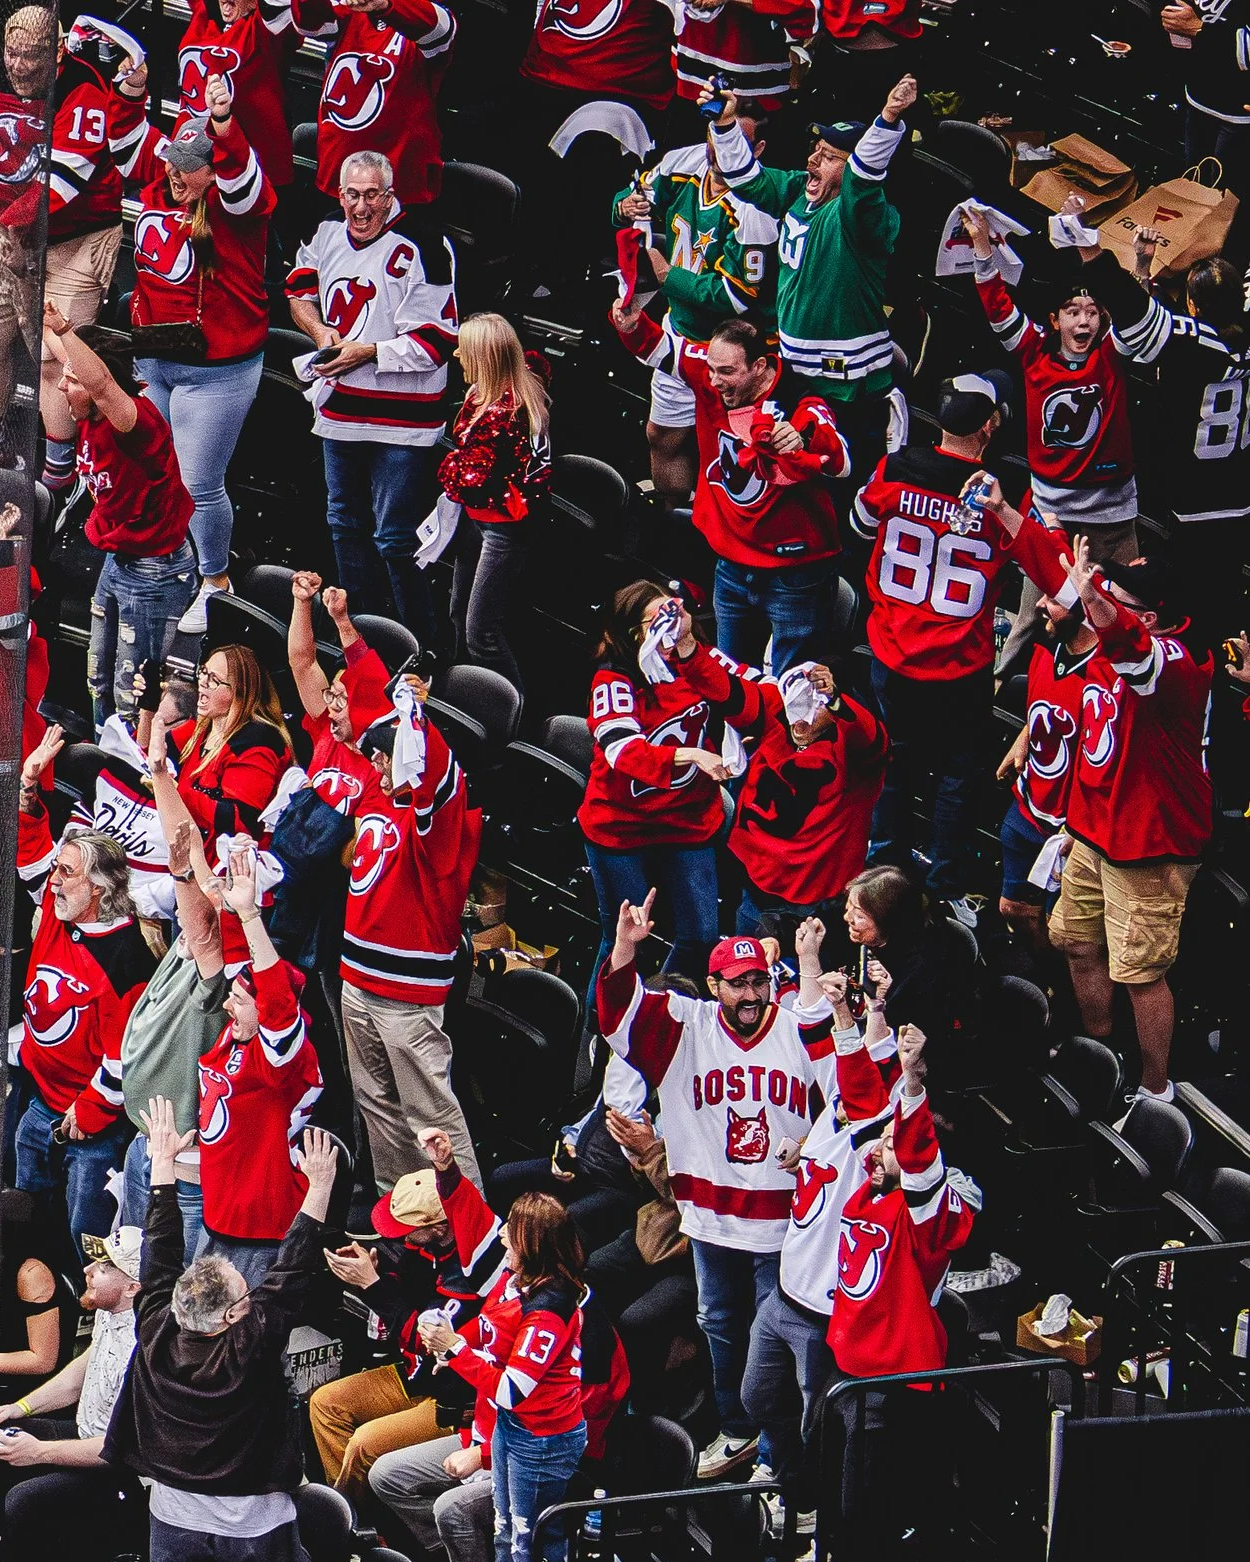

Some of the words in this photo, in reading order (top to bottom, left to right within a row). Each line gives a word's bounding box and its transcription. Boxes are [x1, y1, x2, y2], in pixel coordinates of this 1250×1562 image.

[68, 106, 106, 144] 13
[386, 243, 414, 279] C
[744, 243, 765, 282] 9
[899, 490, 984, 534] HUGHS
[880, 516, 991, 618] 86
[593, 680, 634, 719] 86
[692, 1062, 808, 1120] BOSTON
[517, 1325, 556, 1364] 13
